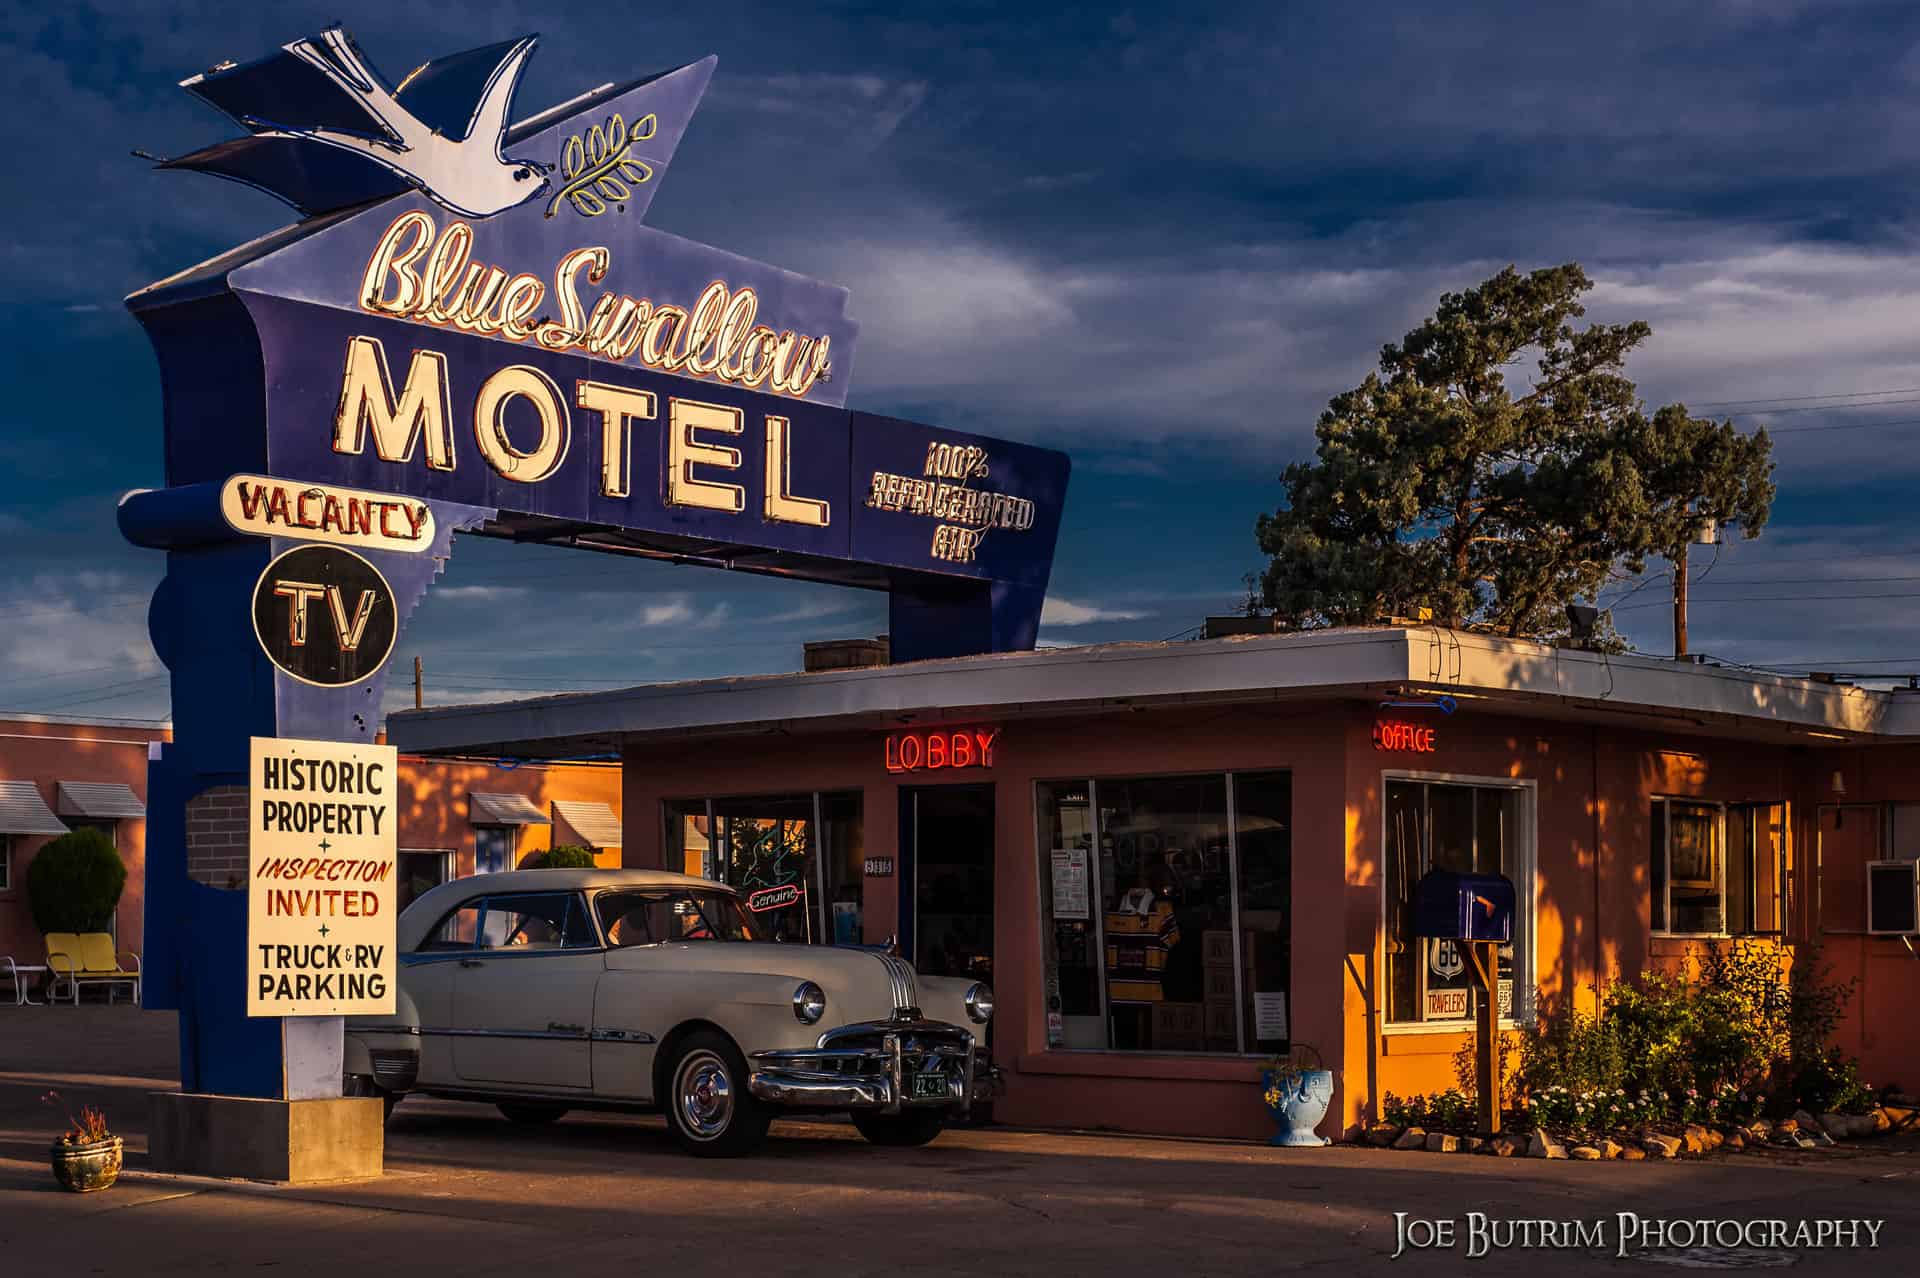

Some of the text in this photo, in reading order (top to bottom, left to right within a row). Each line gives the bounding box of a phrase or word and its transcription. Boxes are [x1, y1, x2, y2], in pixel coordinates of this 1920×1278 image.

[360, 210, 832, 396] Blue Swallow
[332, 335, 829, 527] MOTEL
[925, 441, 990, 479] 100%
[237, 481, 428, 540] VACANCY
[865, 472, 1035, 530] REFRIGERATED
[930, 524, 976, 562] AIR
[273, 579, 376, 652] TV
[886, 733, 994, 769] LOBBY
[1382, 724, 1436, 752] OFFICE
[263, 757, 383, 795] HISTORIC
[263, 800, 386, 835] PROPERTY
[257, 857, 392, 882] INSPECTION
[267, 889, 379, 917] INVITED
[752, 888, 796, 908] Genuine
[259, 944, 384, 969] TRUCK & RV
[1439, 937, 1459, 967] 66
[259, 974, 386, 1000] PARKING
[1428, 993, 1465, 1014] TRAVELERS
